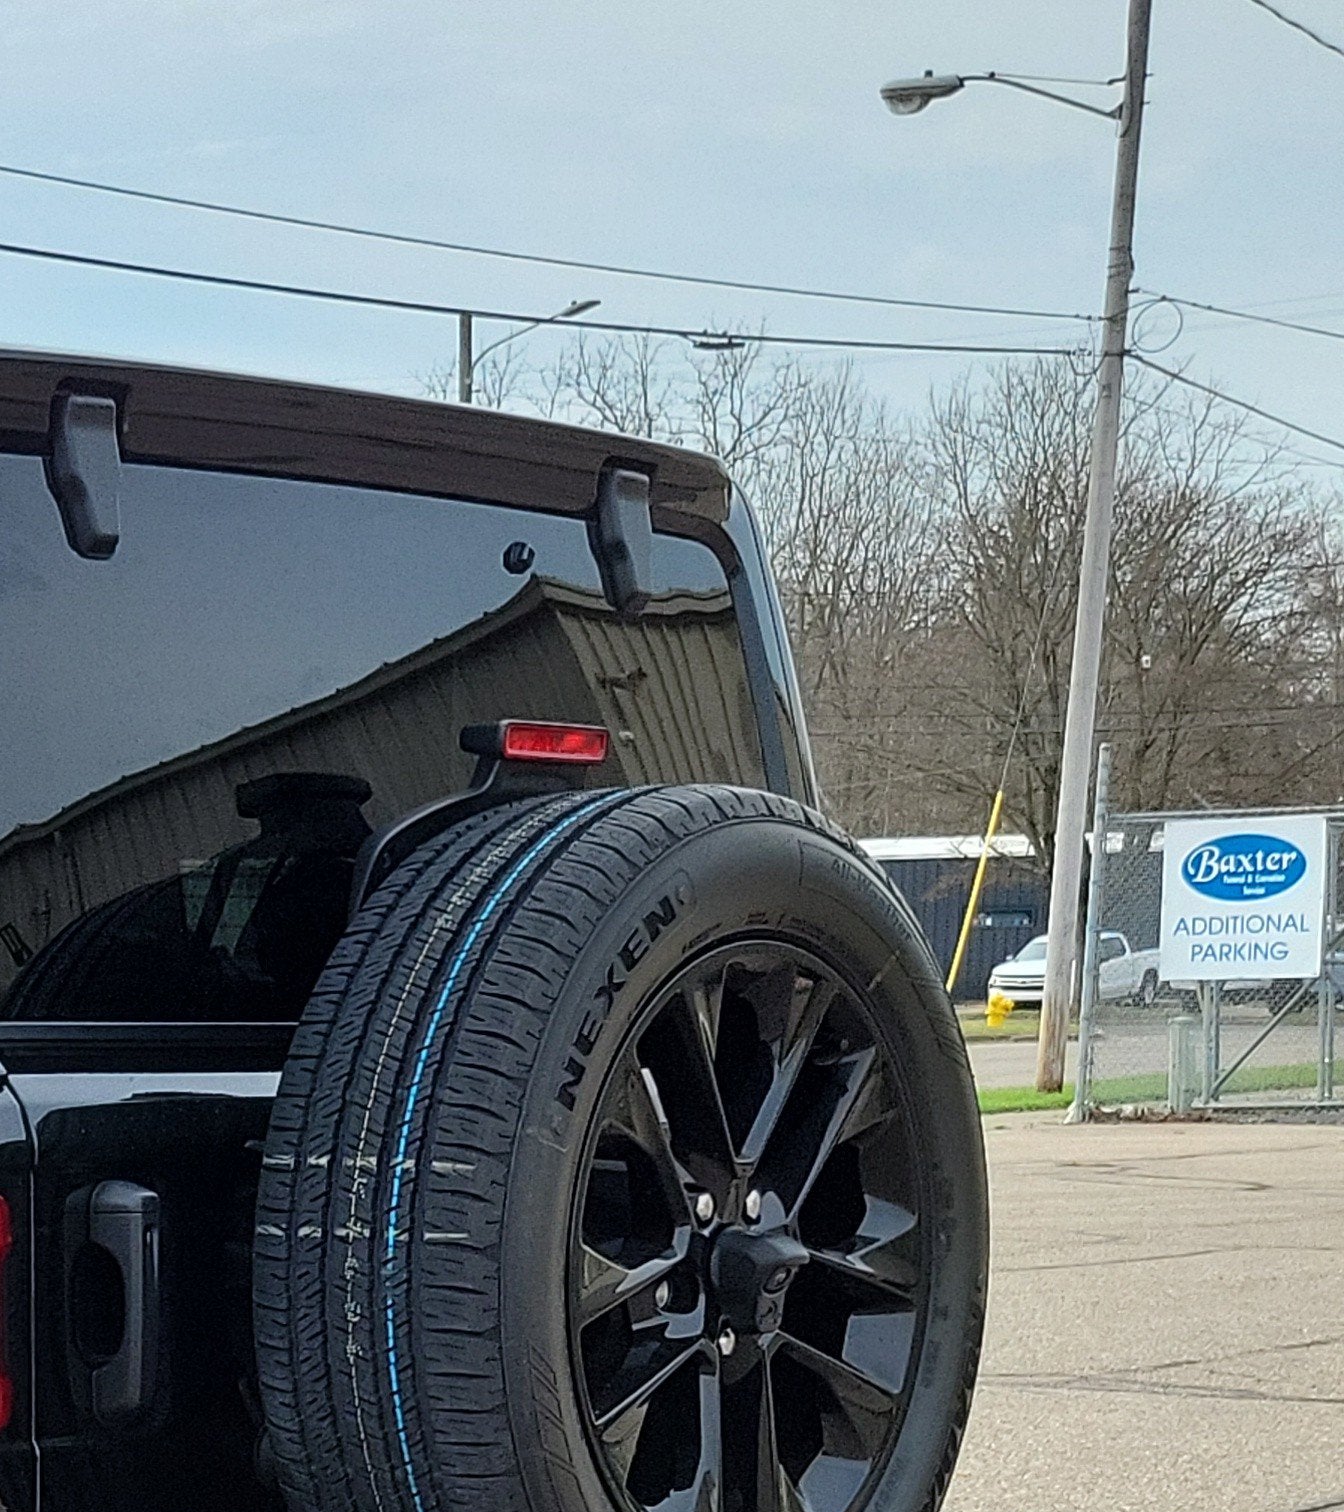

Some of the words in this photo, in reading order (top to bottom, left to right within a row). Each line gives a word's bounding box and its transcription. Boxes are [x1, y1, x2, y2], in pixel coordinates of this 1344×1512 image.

[1188, 846, 1297, 883] Baxter
[1173, 914, 1310, 937] ADDITIONAL
[1190, 941, 1289, 962] PARKING
[554, 895, 677, 1112] NEXEN
